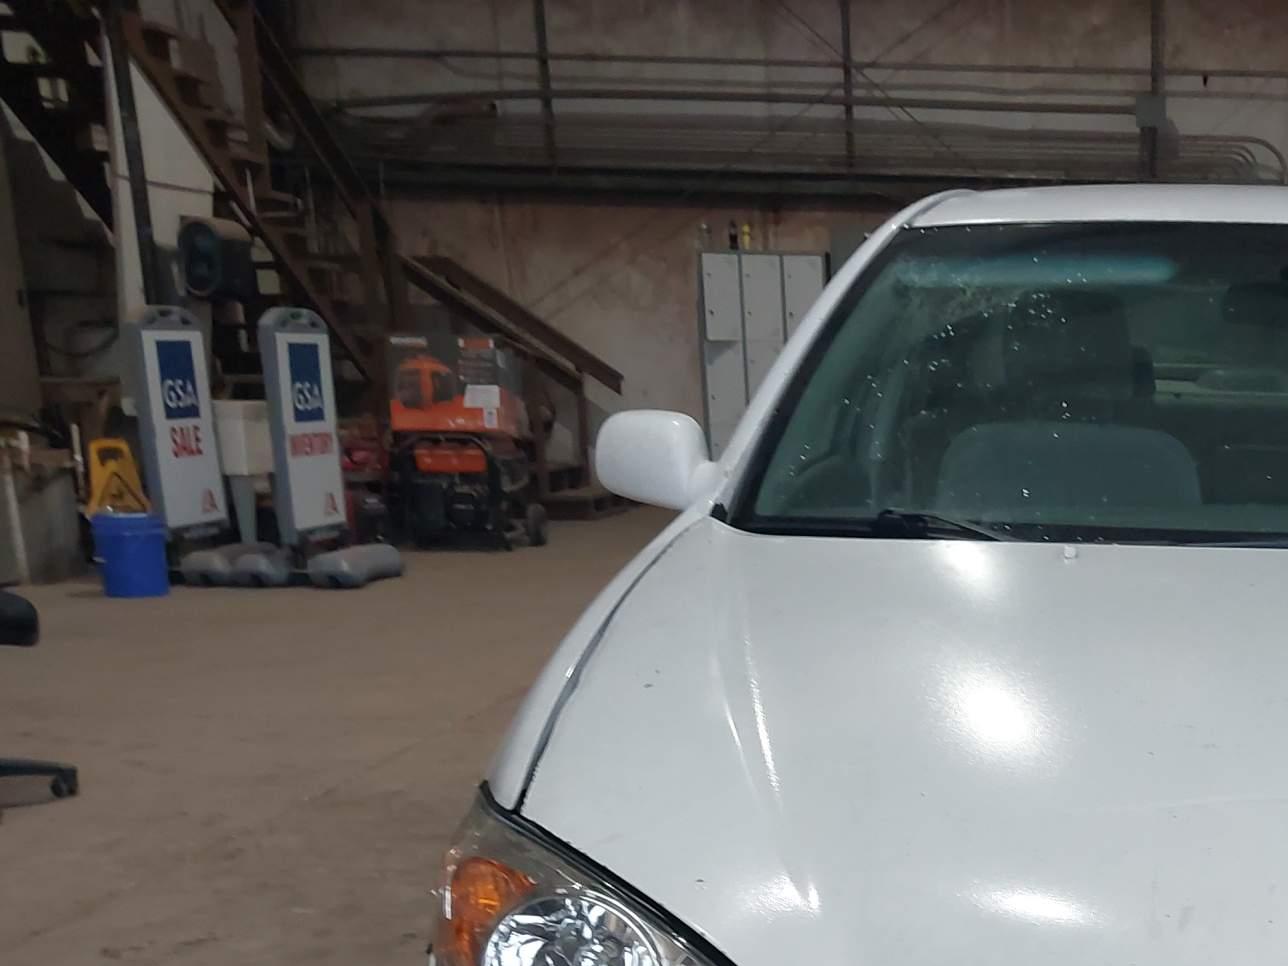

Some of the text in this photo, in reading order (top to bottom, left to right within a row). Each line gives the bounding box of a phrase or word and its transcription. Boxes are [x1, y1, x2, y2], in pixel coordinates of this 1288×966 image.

[163, 379, 198, 408] GSA
[293, 382, 324, 411] GSA
[171, 425, 204, 458] SALE
